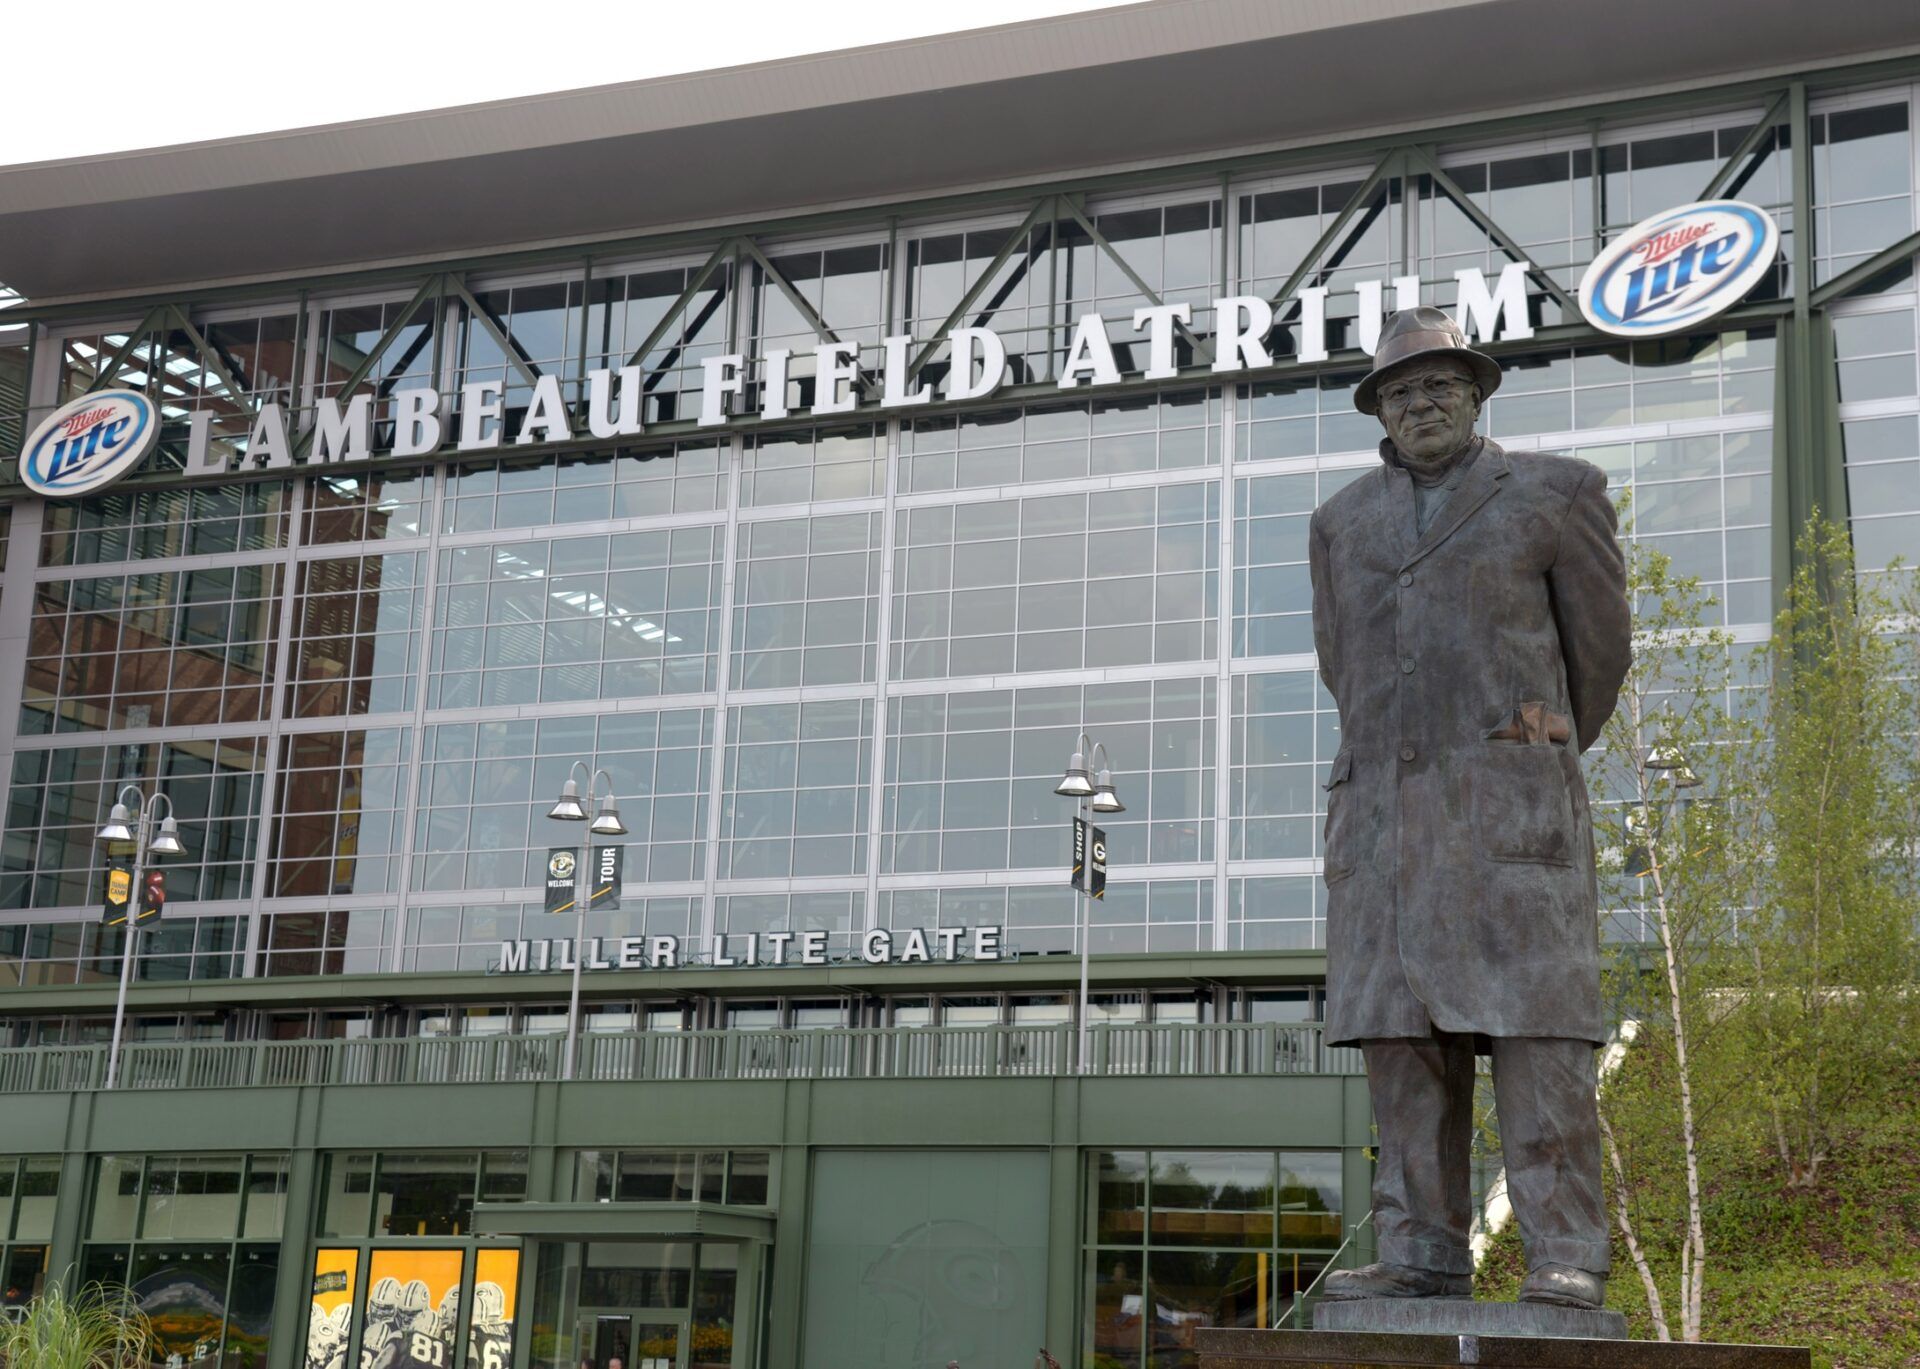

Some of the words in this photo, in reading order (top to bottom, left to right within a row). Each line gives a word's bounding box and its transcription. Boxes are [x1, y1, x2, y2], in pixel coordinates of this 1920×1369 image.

[1632, 222, 1716, 266] Miller
[1620, 231, 1740, 323] Lite
[182, 364, 645, 477] LAMBEAU
[696, 327, 1006, 428] FIELD
[1057, 261, 1536, 390] ATRIUM
[57, 406, 117, 437] Miller
[43, 416, 130, 484] Lite
[1075, 821, 1083, 861] SHOP
[1094, 842, 1106, 860] G
[548, 880, 574, 888] WELCOME
[600, 847, 616, 884] TOUR
[499, 935, 680, 973] MILLER
[711, 931, 831, 967] LITE
[861, 925, 1004, 963] GATE
[194, 1344, 207, 1360] 12
[410, 1332, 443, 1369] 81
